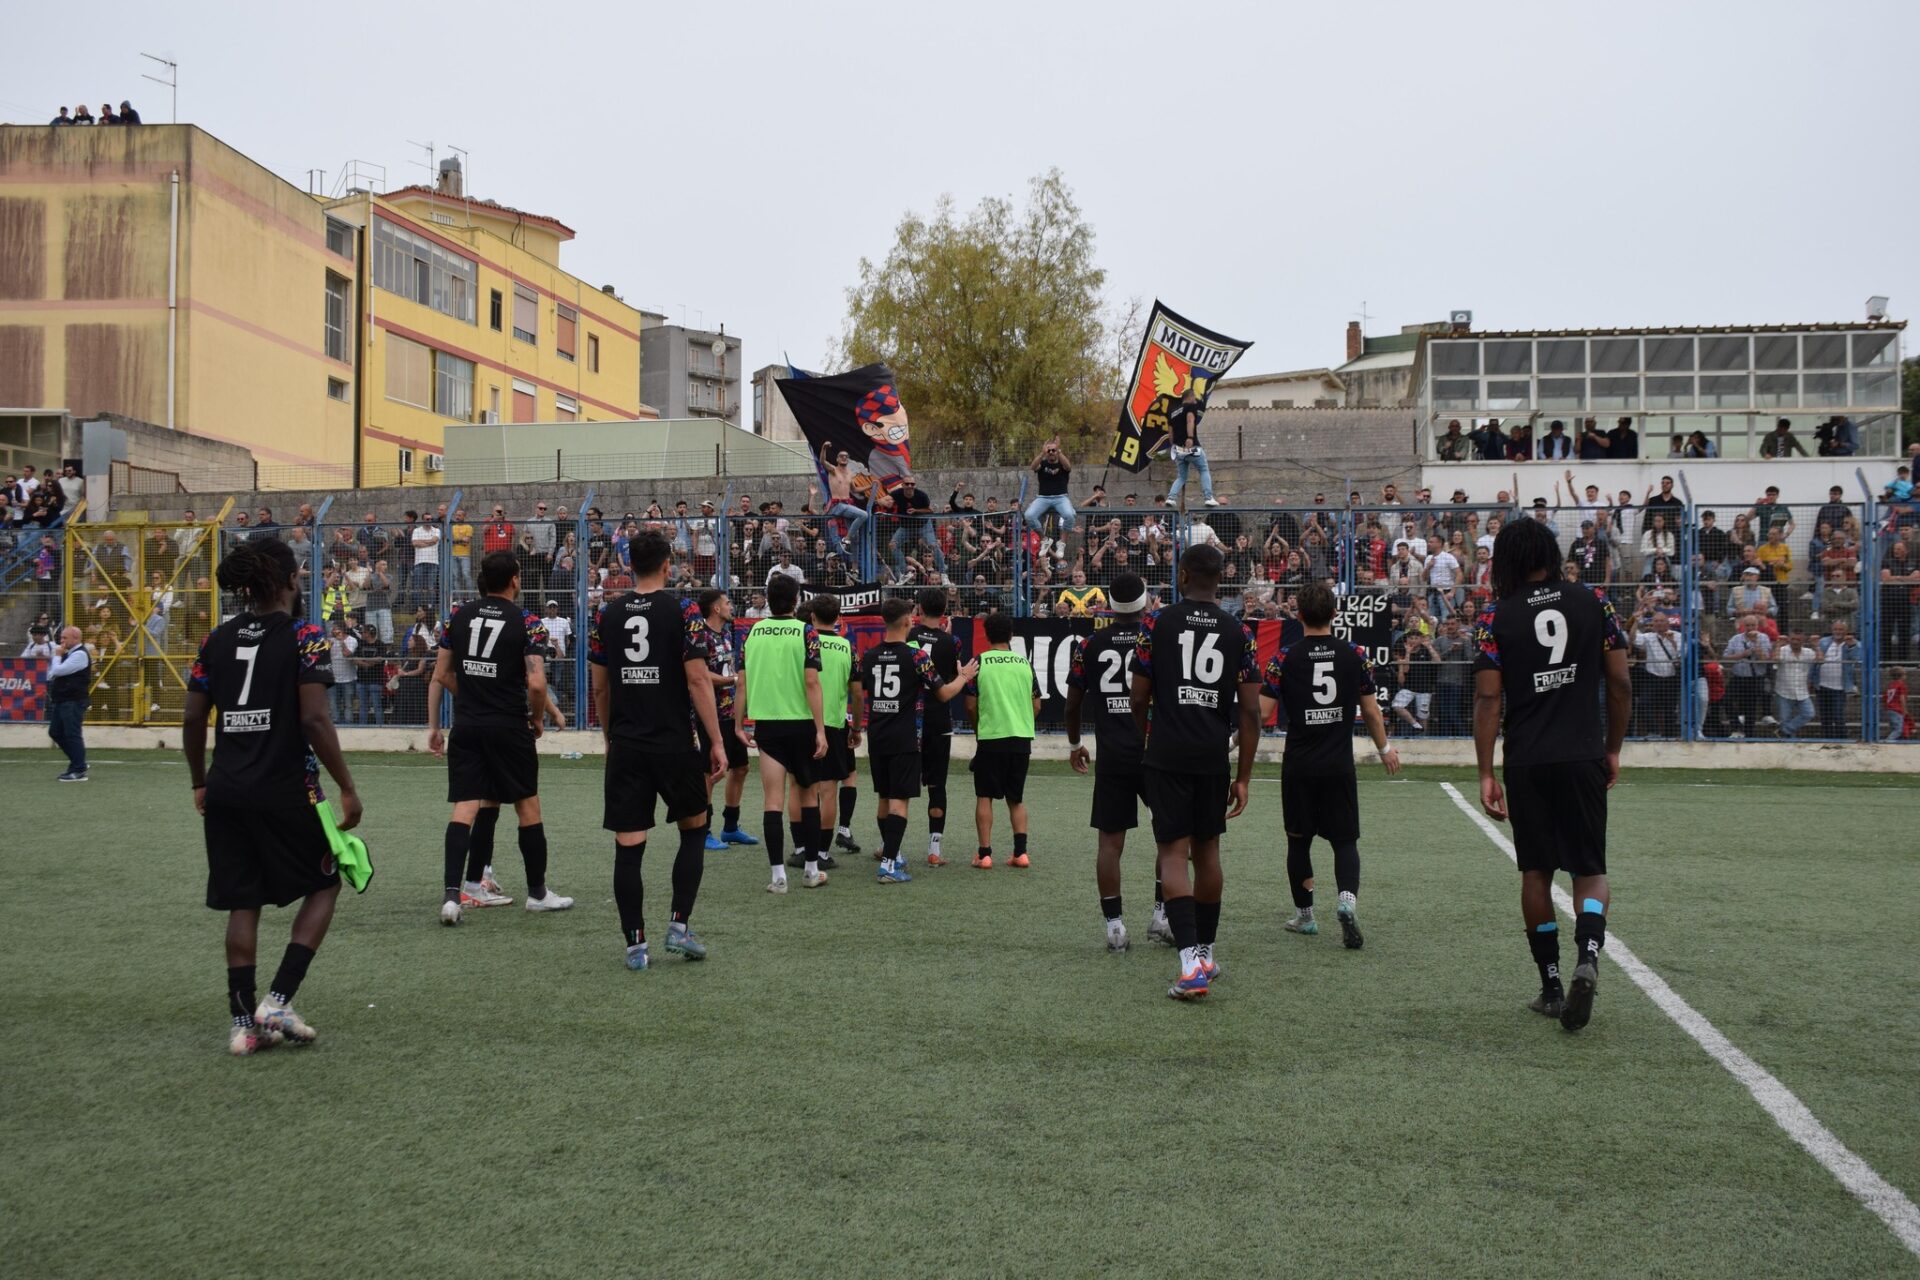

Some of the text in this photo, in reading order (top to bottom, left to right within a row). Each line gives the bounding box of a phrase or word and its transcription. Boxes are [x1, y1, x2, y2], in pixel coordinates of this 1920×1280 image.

[1161, 326, 1229, 369] MODICA
[803, 589, 879, 607] DIDATI
[1335, 595, 1388, 612] TRAS
[753, 626, 801, 637] macron
[1332, 611, 1373, 628] BERI
[468, 617, 506, 658] 17
[624, 616, 650, 662] 3
[1534, 609, 1568, 665] 9
[463, 660, 498, 673] FRANZY'S
[985, 656, 1029, 665] macron
[1178, 630, 1224, 684] 16
[236, 644, 260, 706] 7
[872, 665, 900, 698] 15
[1312, 661, 1337, 705] 5
[1107, 697, 1131, 708] FRAN
[223, 709, 271, 726] FRANZY'S
